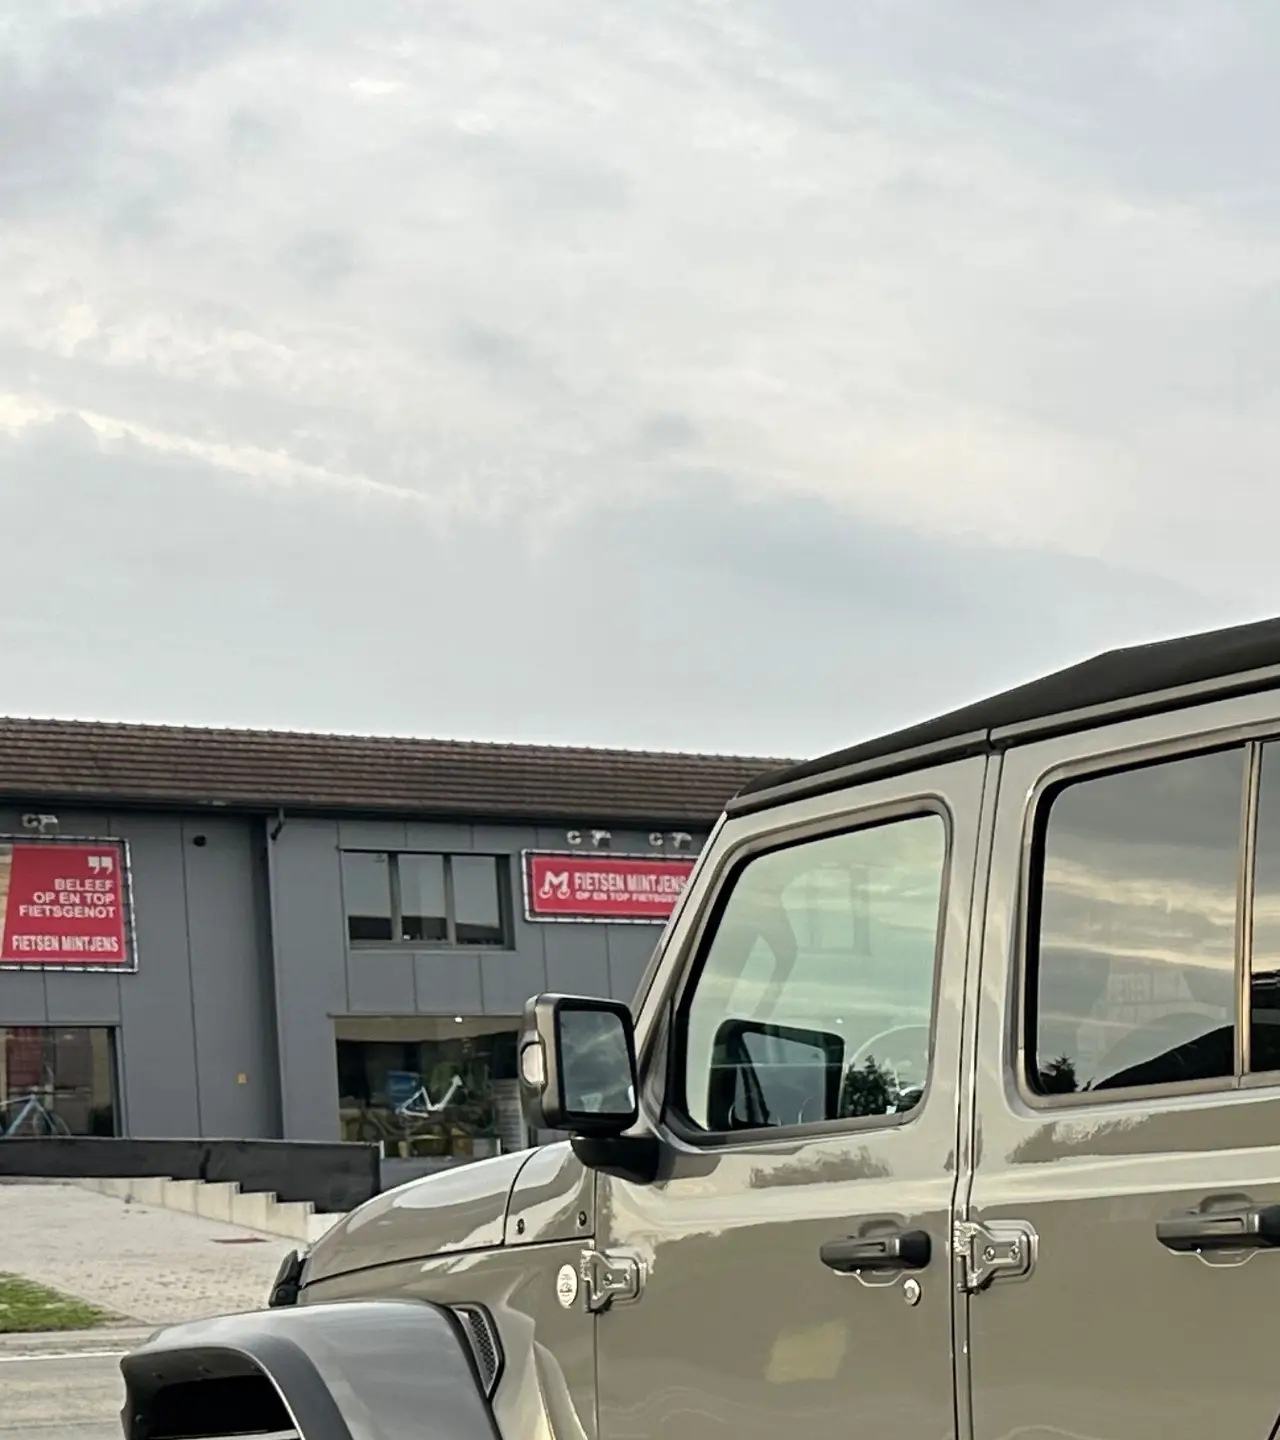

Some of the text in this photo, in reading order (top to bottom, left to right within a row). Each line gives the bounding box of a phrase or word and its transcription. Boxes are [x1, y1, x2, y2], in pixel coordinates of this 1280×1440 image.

[54, 878, 113, 891] BELEEF
[574, 872, 688, 893] FIETSEN MINTJENS
[33, 891, 115, 905] OP EN TOP
[575, 891, 591, 900] OP
[610, 892, 630, 902] TOP
[19, 905, 116, 918] FIETSGENOT
[12, 935, 119, 952] FIETSEN MINTJENS
